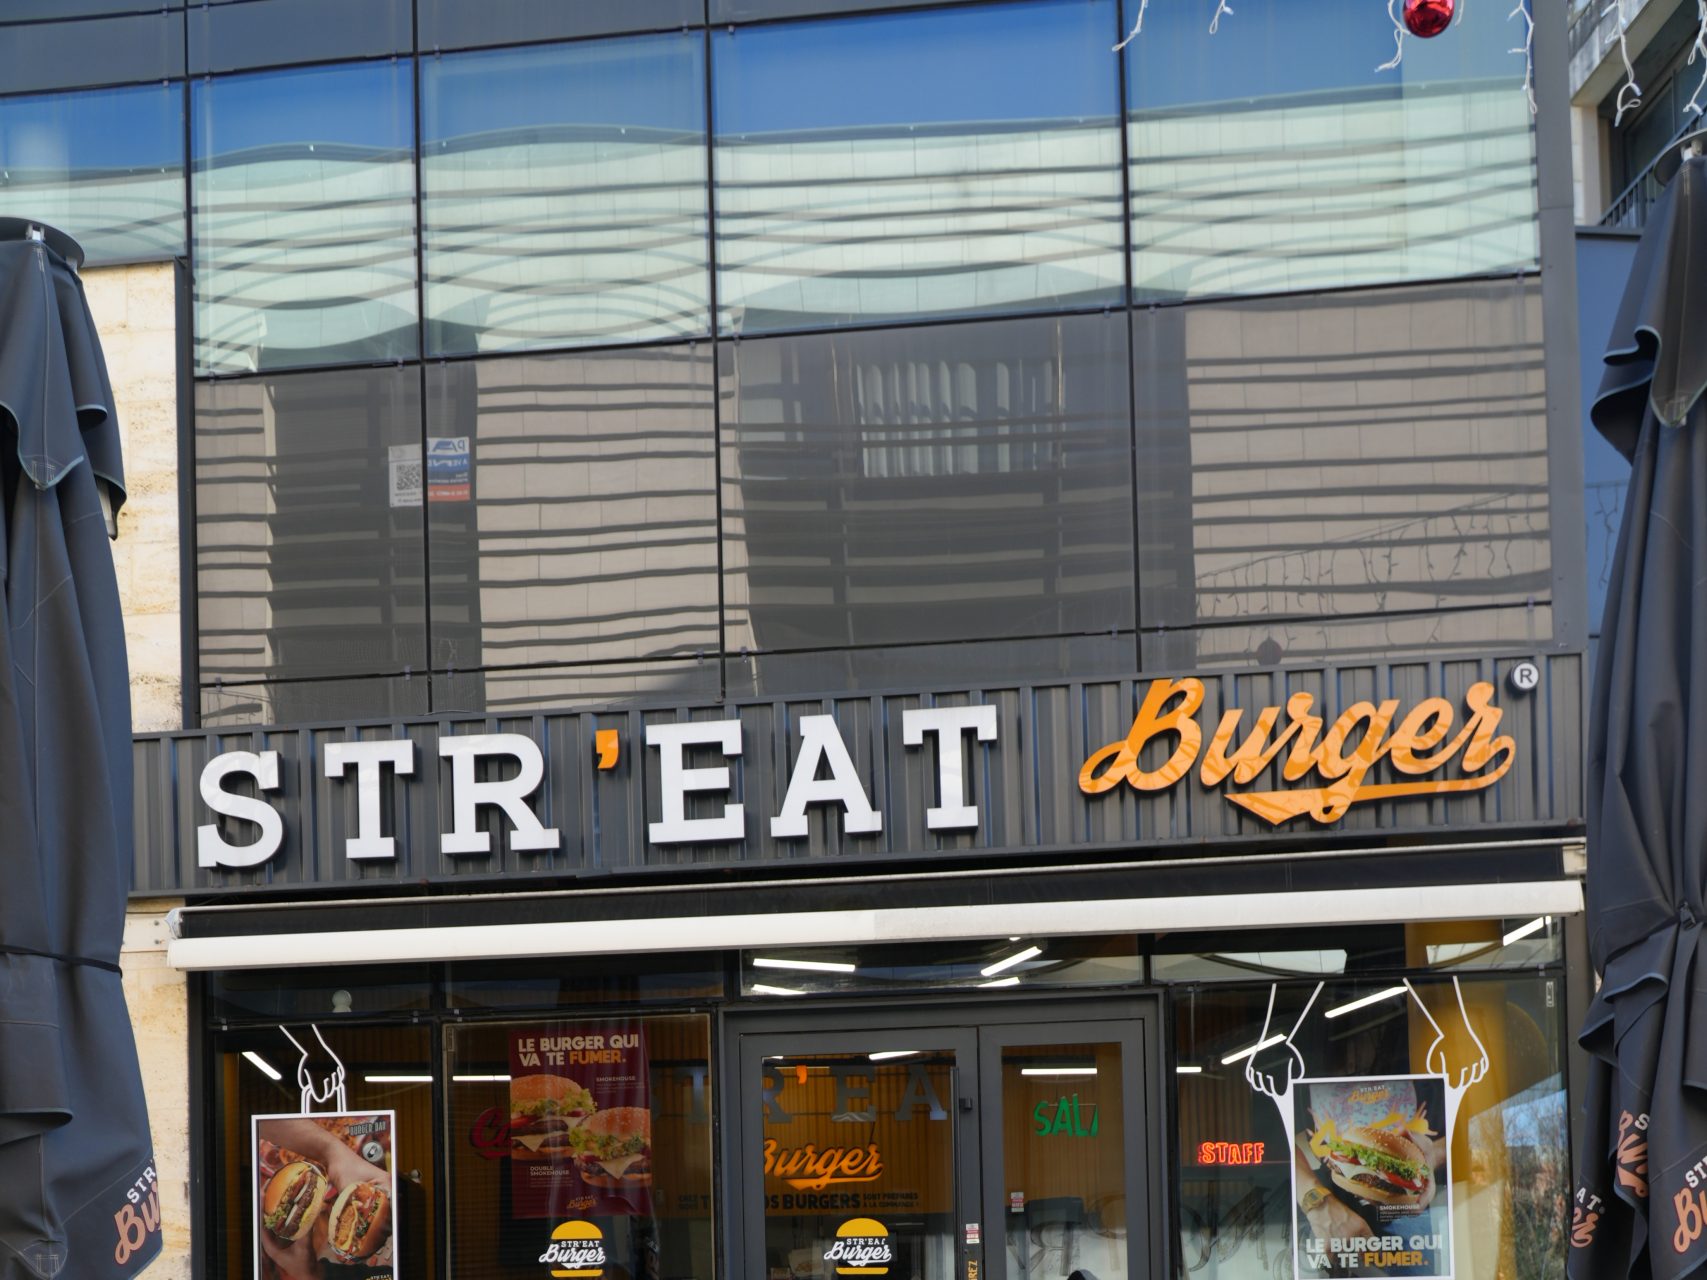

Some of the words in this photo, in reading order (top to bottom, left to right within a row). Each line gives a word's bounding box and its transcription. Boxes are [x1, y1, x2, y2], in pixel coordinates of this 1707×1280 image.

[197, 704, 998, 868] STR'EAT
[1078, 677, 1517, 826] Burger
[518, 1038, 535, 1052] LE
[540, 1036, 604, 1051] BURGER
[609, 1034, 639, 1048] QUI
[520, 1053, 541, 1067] VA
[546, 1052, 565, 1066] TE
[569, 1050, 626, 1064] FUMER.
[350, 1123, 373, 1136] BURGER
[1200, 1142, 1265, 1164] STAFF
[783, 1193, 861, 1209] BURGERS
[561, 1240, 600, 1248] STR'EAT
[1305, 1238, 1325, 1253] LE
[1331, 1235, 1403, 1252] BURGER
[1409, 1234, 1442, 1250] QUI
[539, 1244, 606, 1269] Burger
[823, 1240, 892, 1266] Burger
[1307, 1254, 1332, 1269] VA
[1337, 1253, 1358, 1268] TE
[1364, 1251, 1428, 1267] FUMER.
